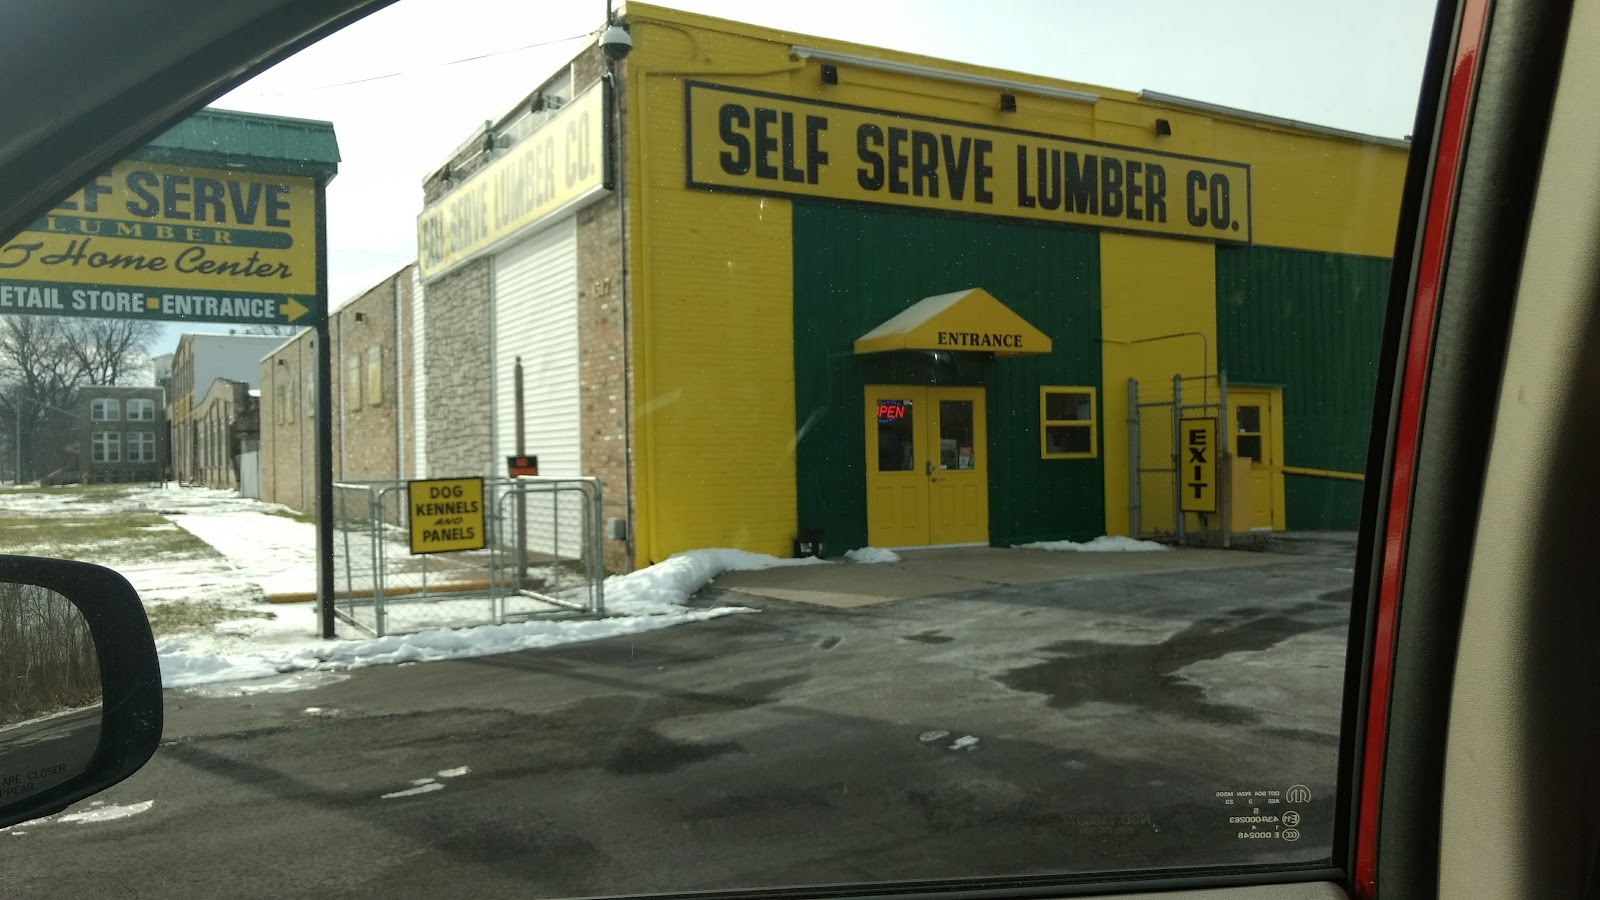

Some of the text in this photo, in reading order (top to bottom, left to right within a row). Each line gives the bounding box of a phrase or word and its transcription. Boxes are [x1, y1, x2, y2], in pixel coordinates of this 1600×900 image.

[493, 134, 556, 231] LUMBER
[565, 109, 596, 189] CO.
[718, 103, 1239, 232] SELF SERVE LUMBER CO.
[126, 170, 291, 229] SERVE
[47, 217, 233, 246] LUMBER
[40, 237, 168, 273] Home
[174, 245, 294, 280] Center
[71, 288, 145, 314] STORE
[162, 294, 275, 319] ENTRANCE
[937, 331, 1023, 348] ENTRANCE
[1188, 429, 1208, 499] EXIT
[430, 485, 463, 499] DOG
[416, 501, 479, 516] KENNELS
[434, 516, 463, 526] AND
[423, 526, 475, 542] PANELS
[1, 764, 66, 787] ARE CLOSER
